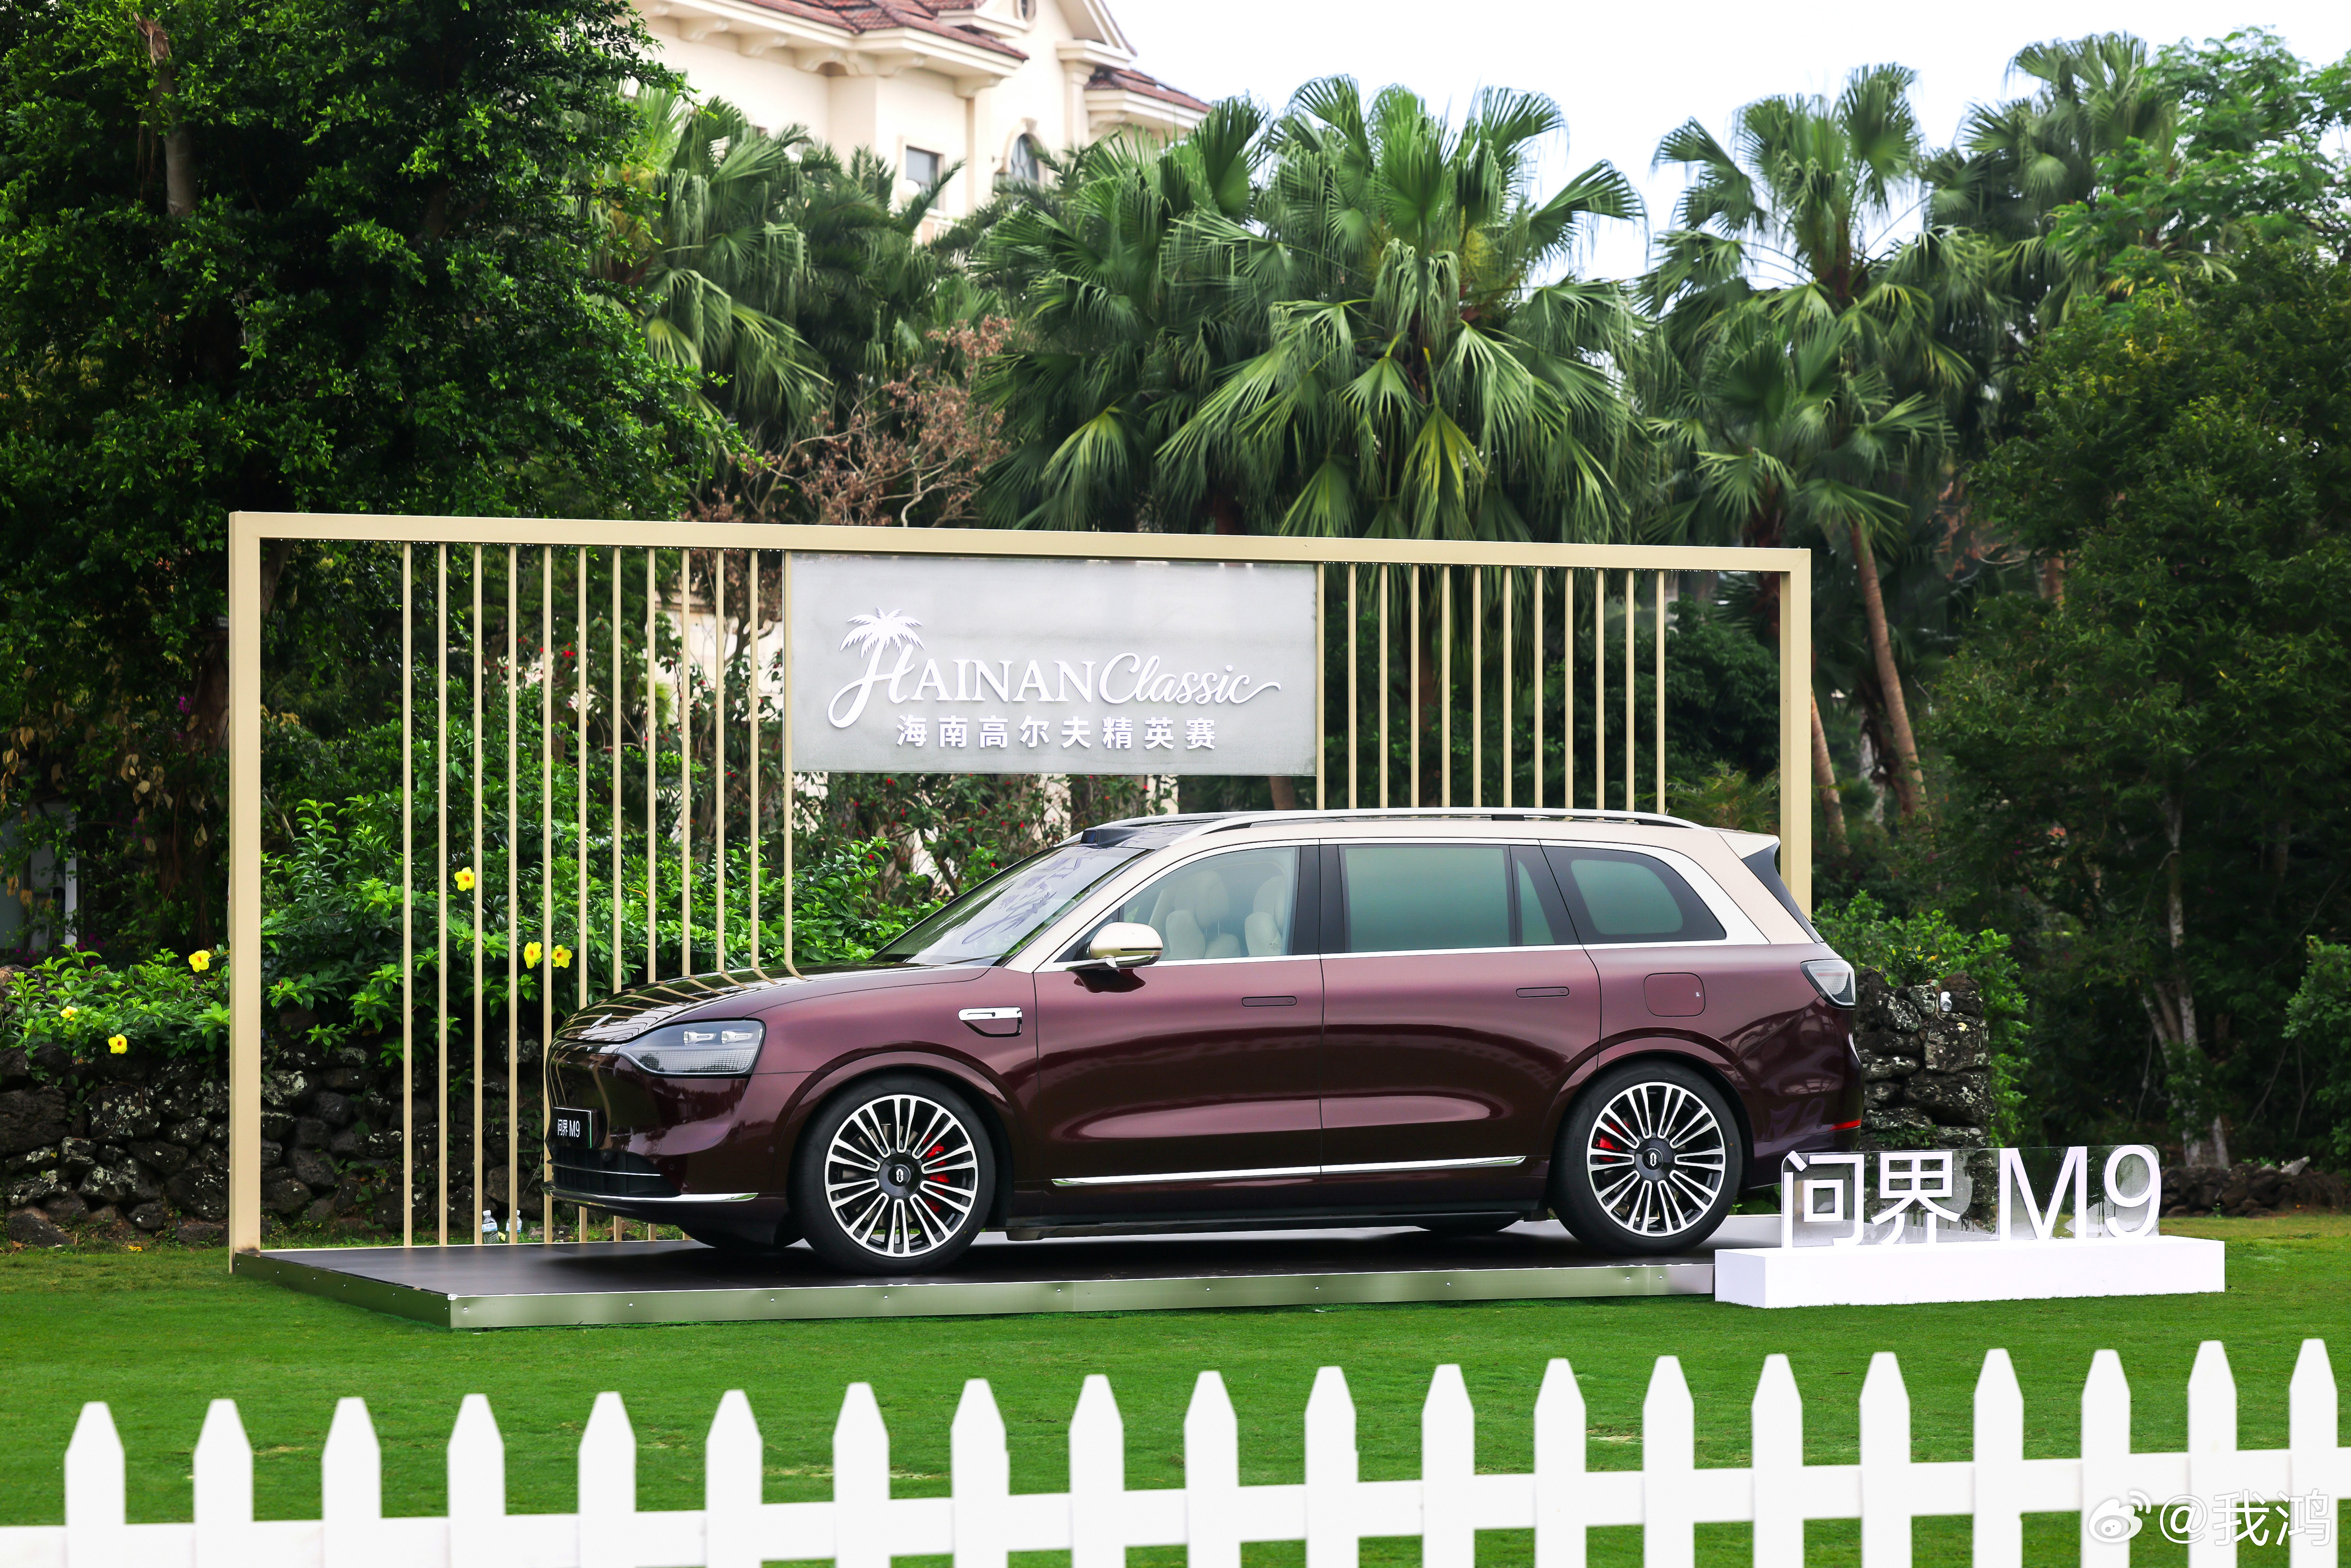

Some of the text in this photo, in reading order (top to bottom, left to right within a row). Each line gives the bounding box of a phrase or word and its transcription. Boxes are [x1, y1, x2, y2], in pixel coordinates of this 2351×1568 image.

[828, 642, 1281, 728] HAINAN Classic
[896, 713, 1216, 750] 海南高尔夫精英赛
[557, 1118, 580, 1138] 问界 M9
[1781, 1144, 2161, 1248] 问界 M9
